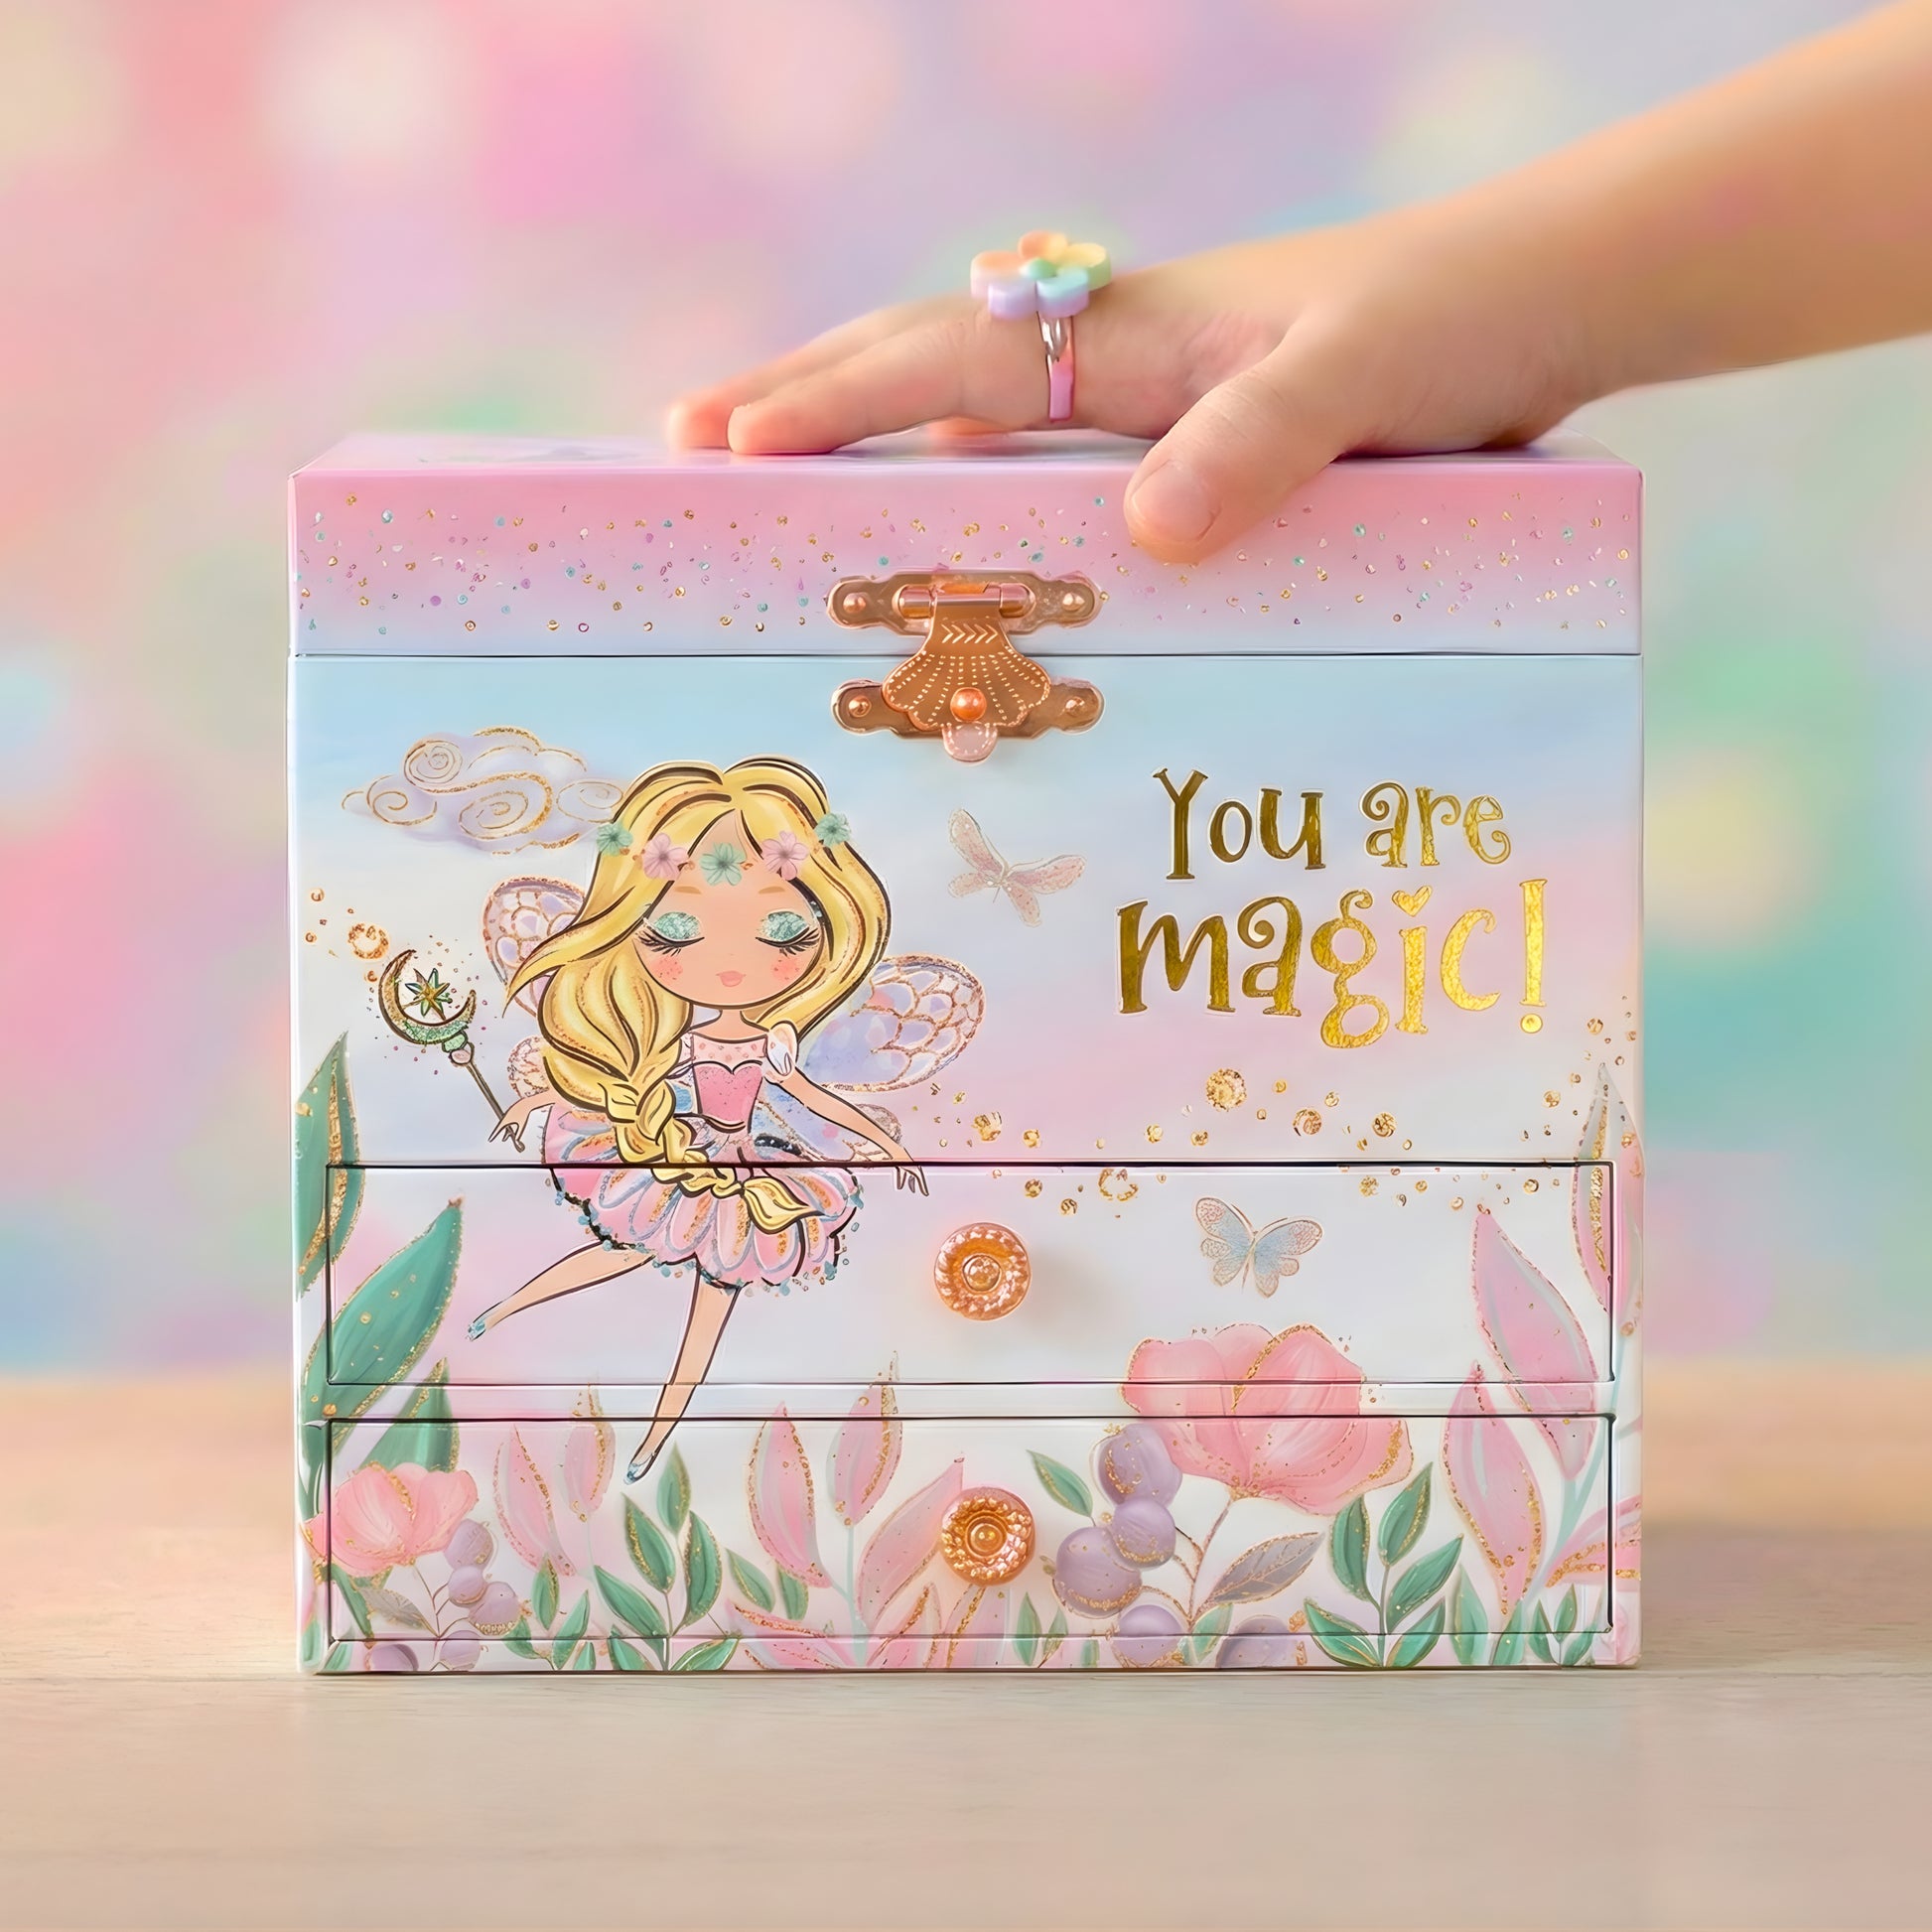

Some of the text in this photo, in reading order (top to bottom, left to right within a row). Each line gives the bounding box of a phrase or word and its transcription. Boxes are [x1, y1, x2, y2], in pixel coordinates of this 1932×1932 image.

[1153, 767, 1512, 881] You are
[1116, 879, 1549, 1049] magic!
